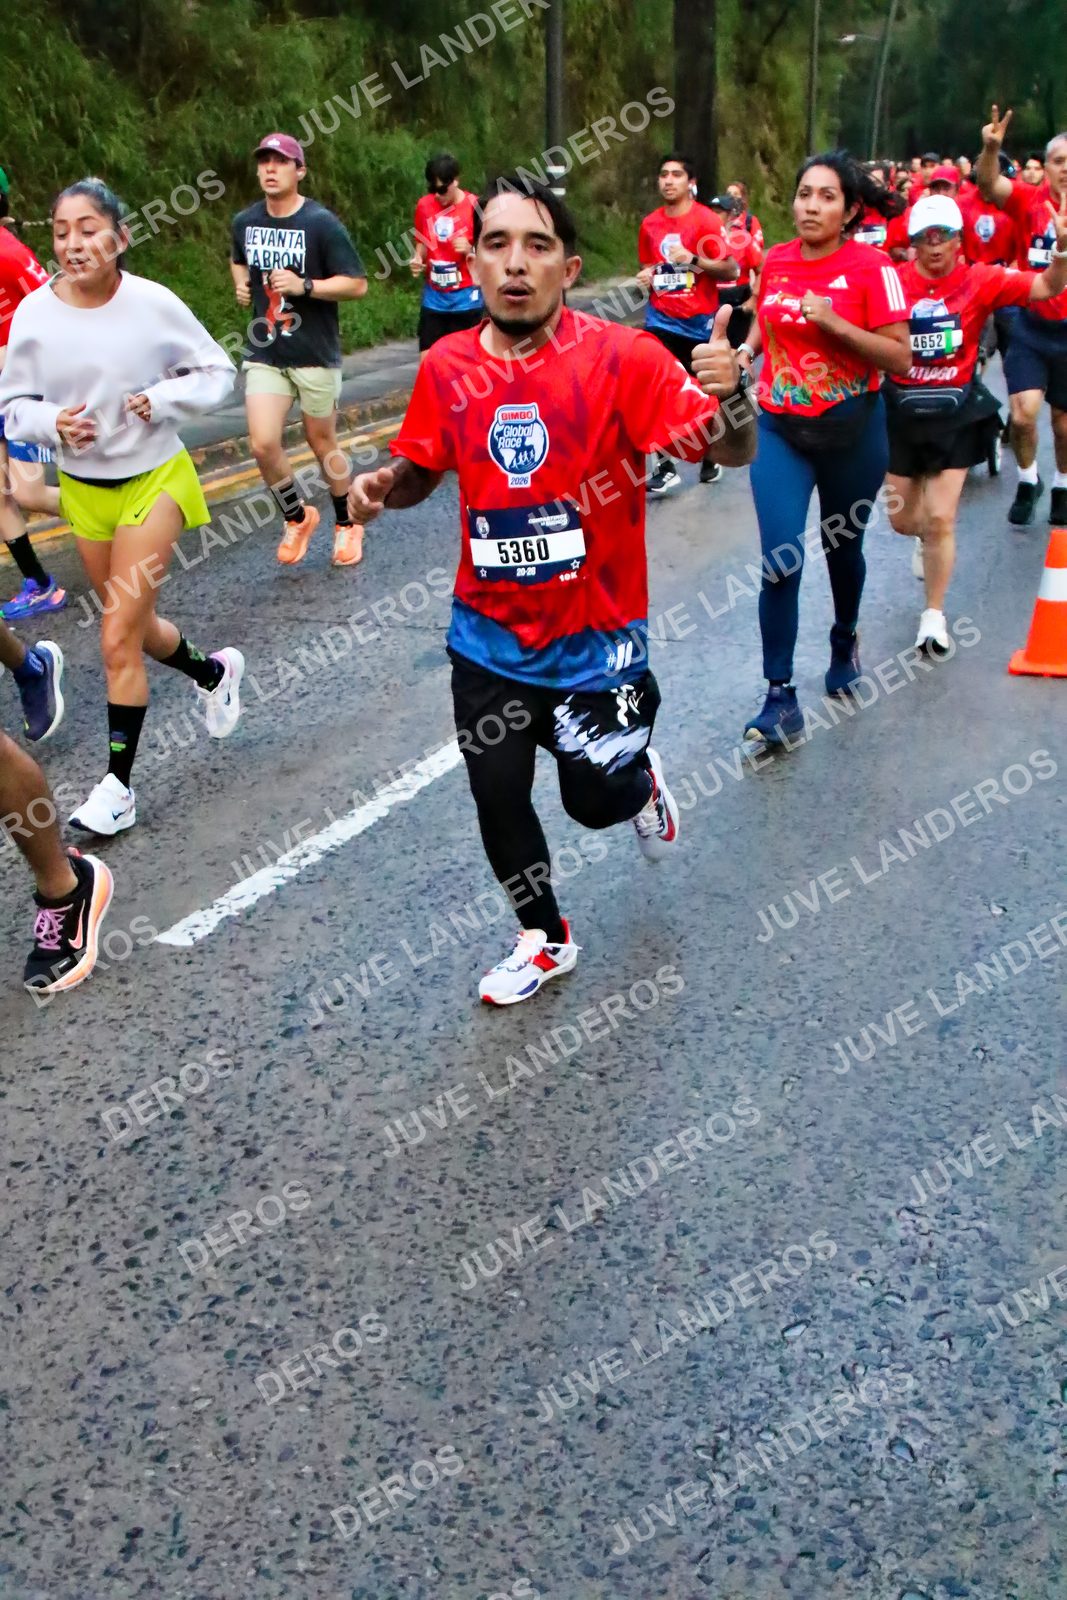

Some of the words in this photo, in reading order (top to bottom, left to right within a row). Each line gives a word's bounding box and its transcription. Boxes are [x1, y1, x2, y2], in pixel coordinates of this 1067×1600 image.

[246, 227, 304, 249] LEVANTA
[913, 334, 943, 349] 4652
[501, 411, 533, 421] BIMBO
[503, 424, 534, 437] Global
[498, 437, 522, 448] Race
[510, 476, 529, 485] 2026
[497, 537, 550, 564] 5360
[559, 571, 578, 582] 10K
